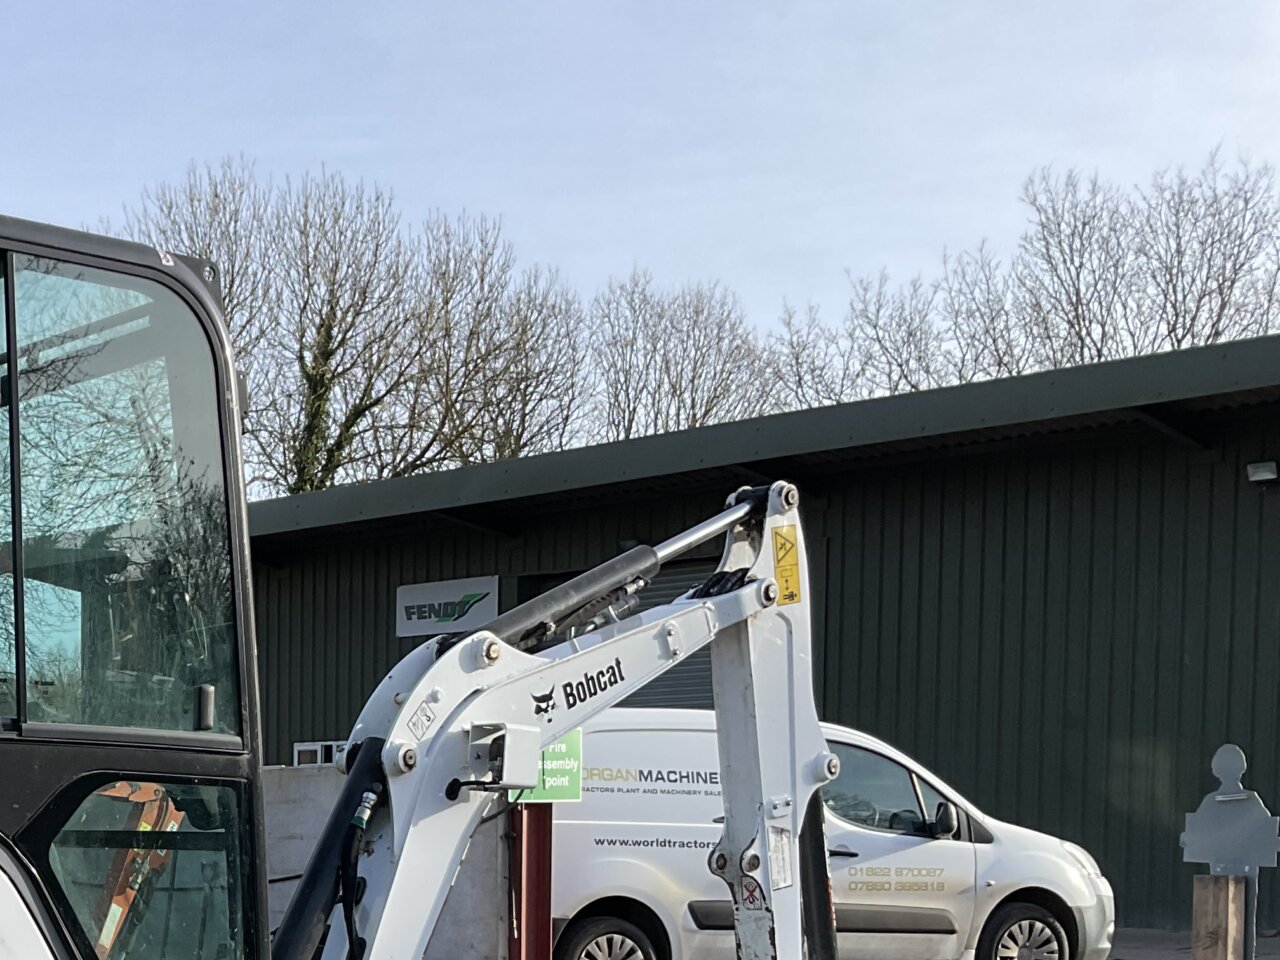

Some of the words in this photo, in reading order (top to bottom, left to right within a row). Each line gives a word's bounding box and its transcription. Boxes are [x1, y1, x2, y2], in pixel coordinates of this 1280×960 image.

[404, 600, 474, 621] FENDT
[562, 656, 625, 710] Bobcat
[545, 775, 570, 790] point
[582, 767, 719, 785] ORGANMACHINE
[659, 788, 702, 796] MACHINERY
[594, 838, 717, 849] www.worldtractors
